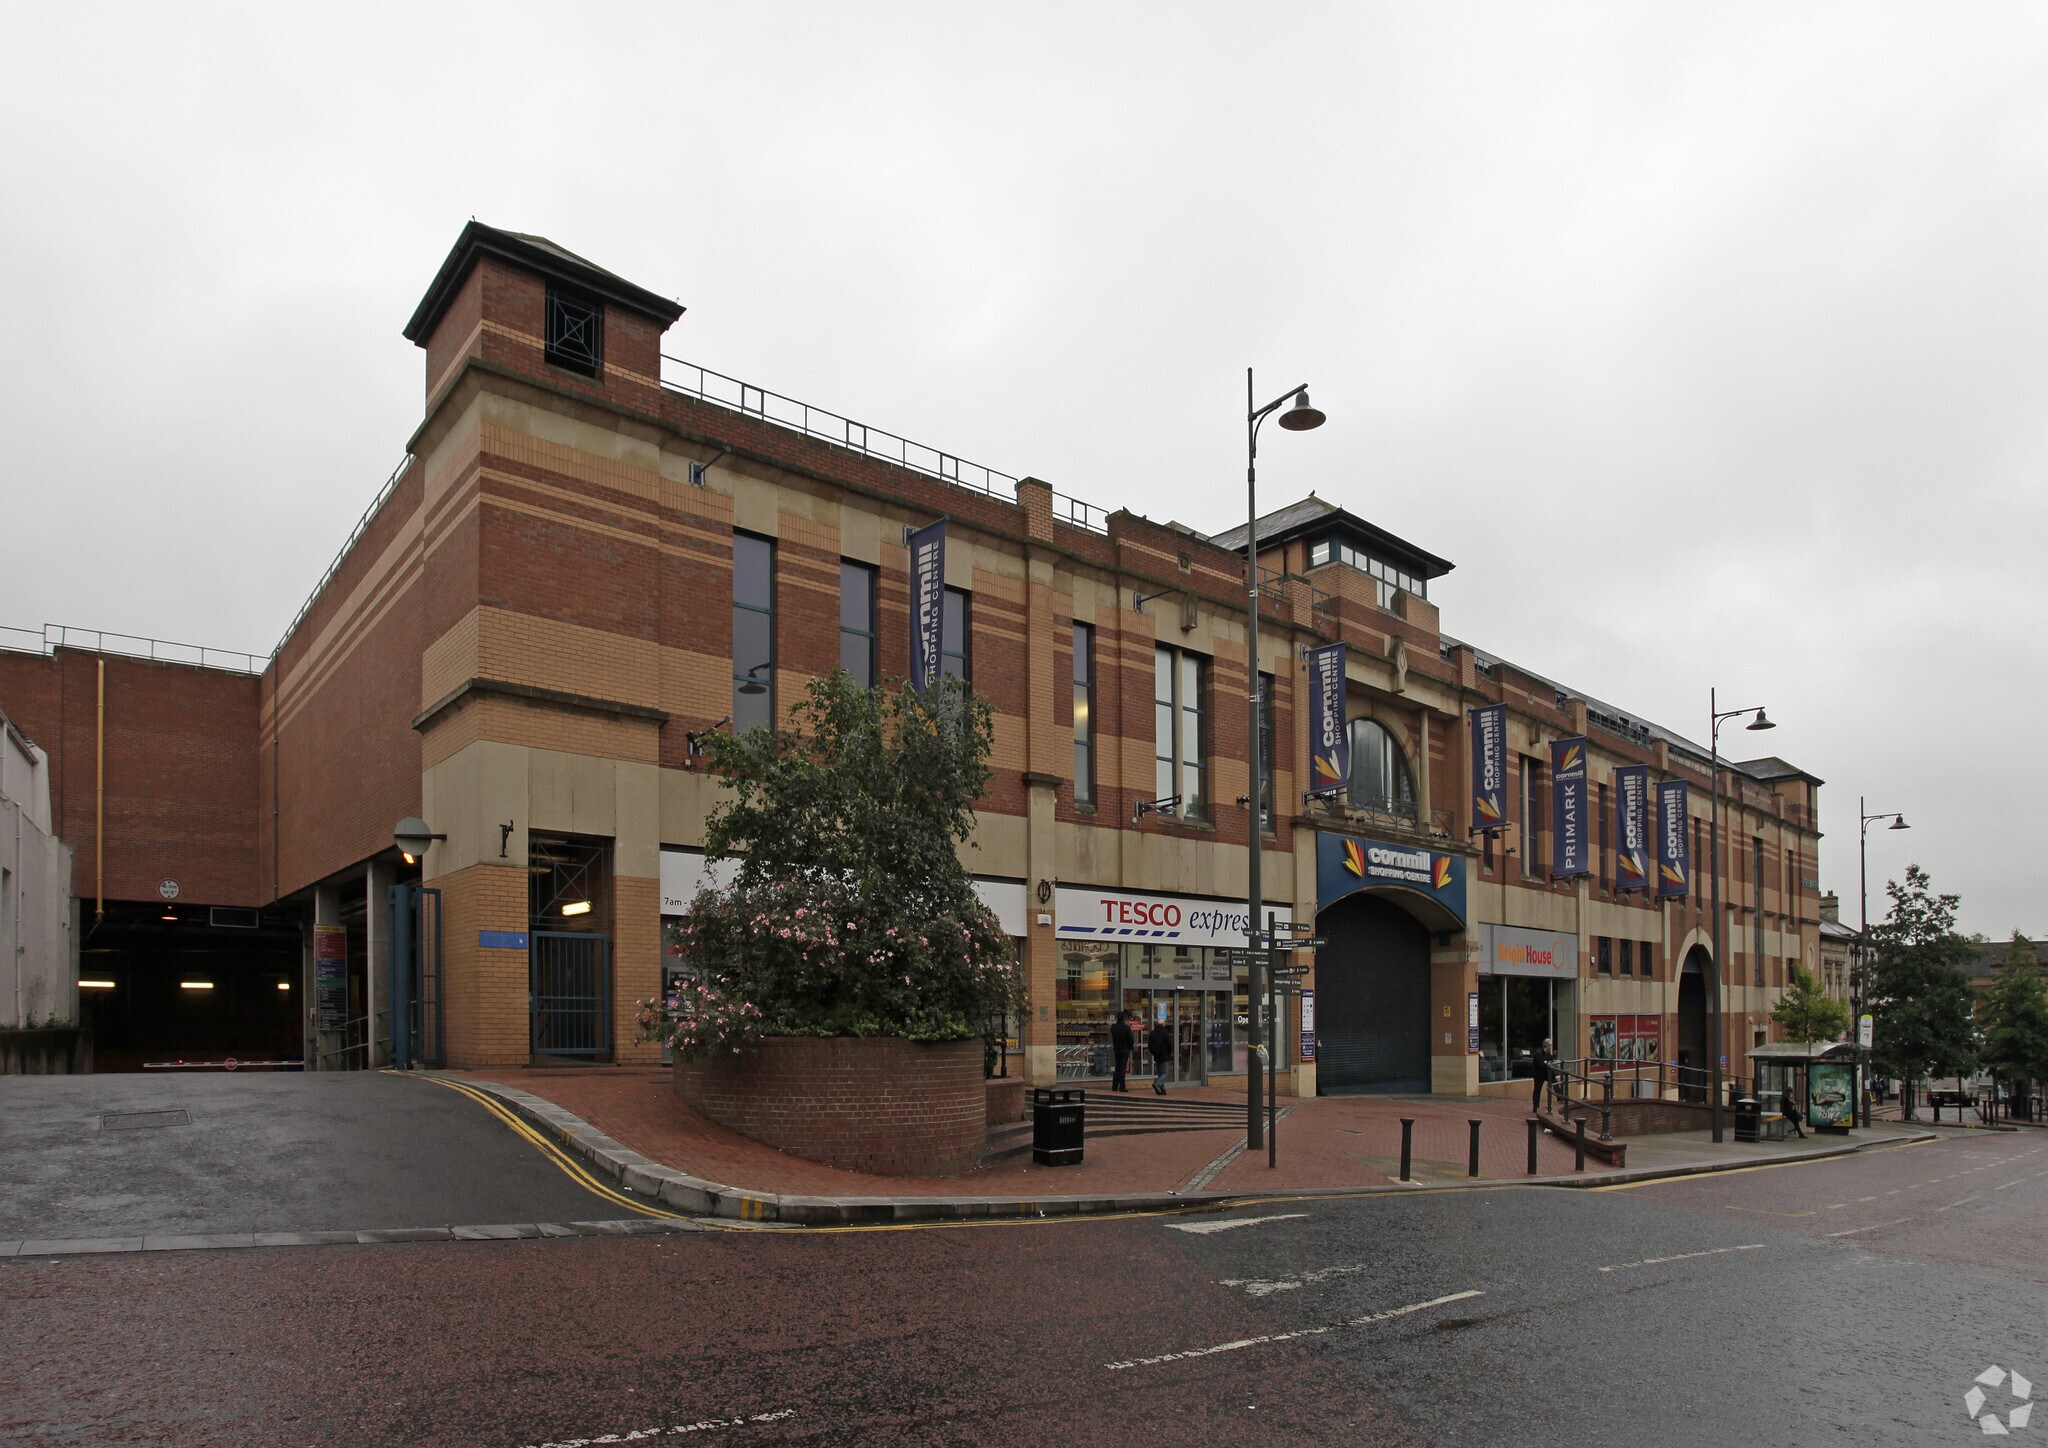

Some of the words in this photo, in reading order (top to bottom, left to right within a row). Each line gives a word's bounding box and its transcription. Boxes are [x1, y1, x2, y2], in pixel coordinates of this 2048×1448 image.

[1331, 650, 1339, 691] CENTRE
[1318, 651, 1335, 748] cornmill
[1334, 693, 1342, 745] SHOPPING
[1480, 710, 1494, 791] cornmill
[1565, 784, 1576, 869] PRIMARK
[1624, 775, 1637, 849] cornmill
[1664, 789, 1678, 859] cornmill
[1368, 847, 1431, 871] cornmill
[1368, 866, 1404, 880] SHOPPING
[1405, 869, 1431, 884] CENTRE
[664, 897, 682, 906] 7am
[1100, 899, 1182, 927] TESCO
[1189, 909, 1249, 937] expres
